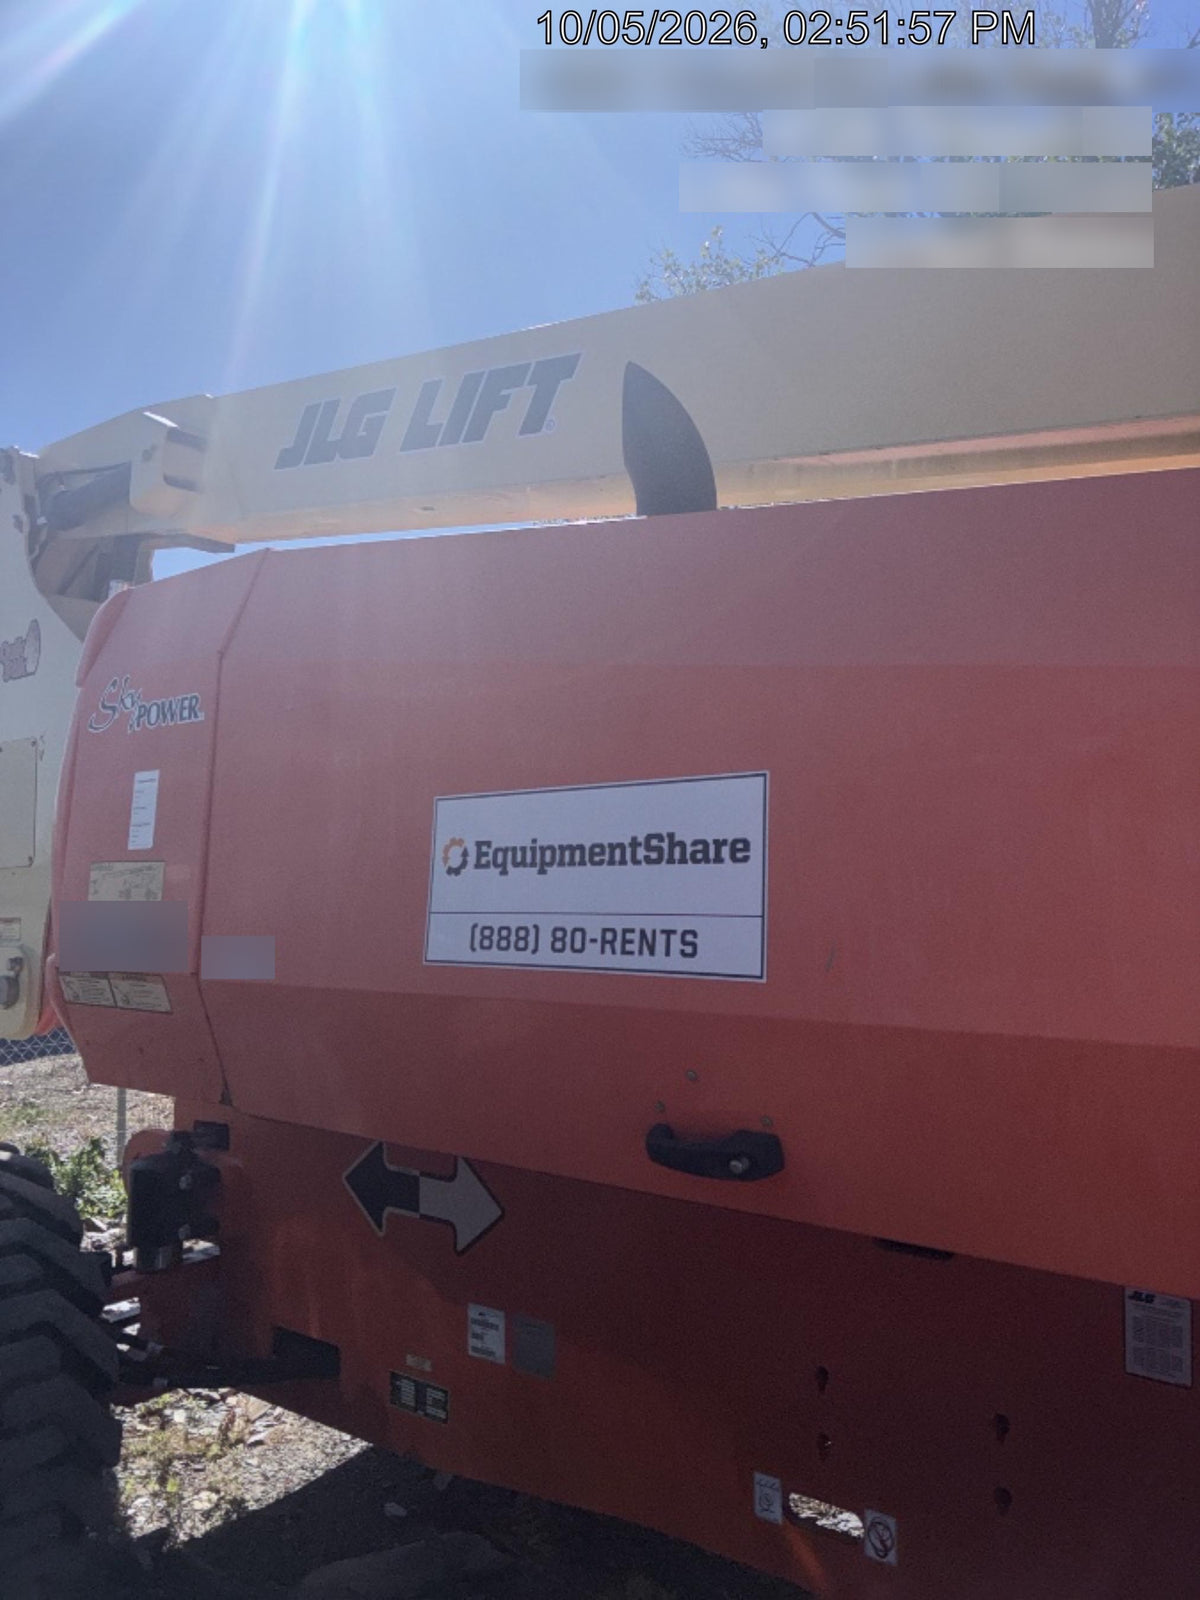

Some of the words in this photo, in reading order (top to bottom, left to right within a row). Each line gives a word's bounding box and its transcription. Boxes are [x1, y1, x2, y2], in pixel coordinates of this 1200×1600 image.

[273, 387, 397, 471] JLG
[399, 352, 582, 455] LIFT
[134, 693, 202, 729] POWER
[473, 832, 751, 876] EquipmentShare
[469, 923, 540, 955] (888)
[550, 926, 699, 959] 80-RENTS
